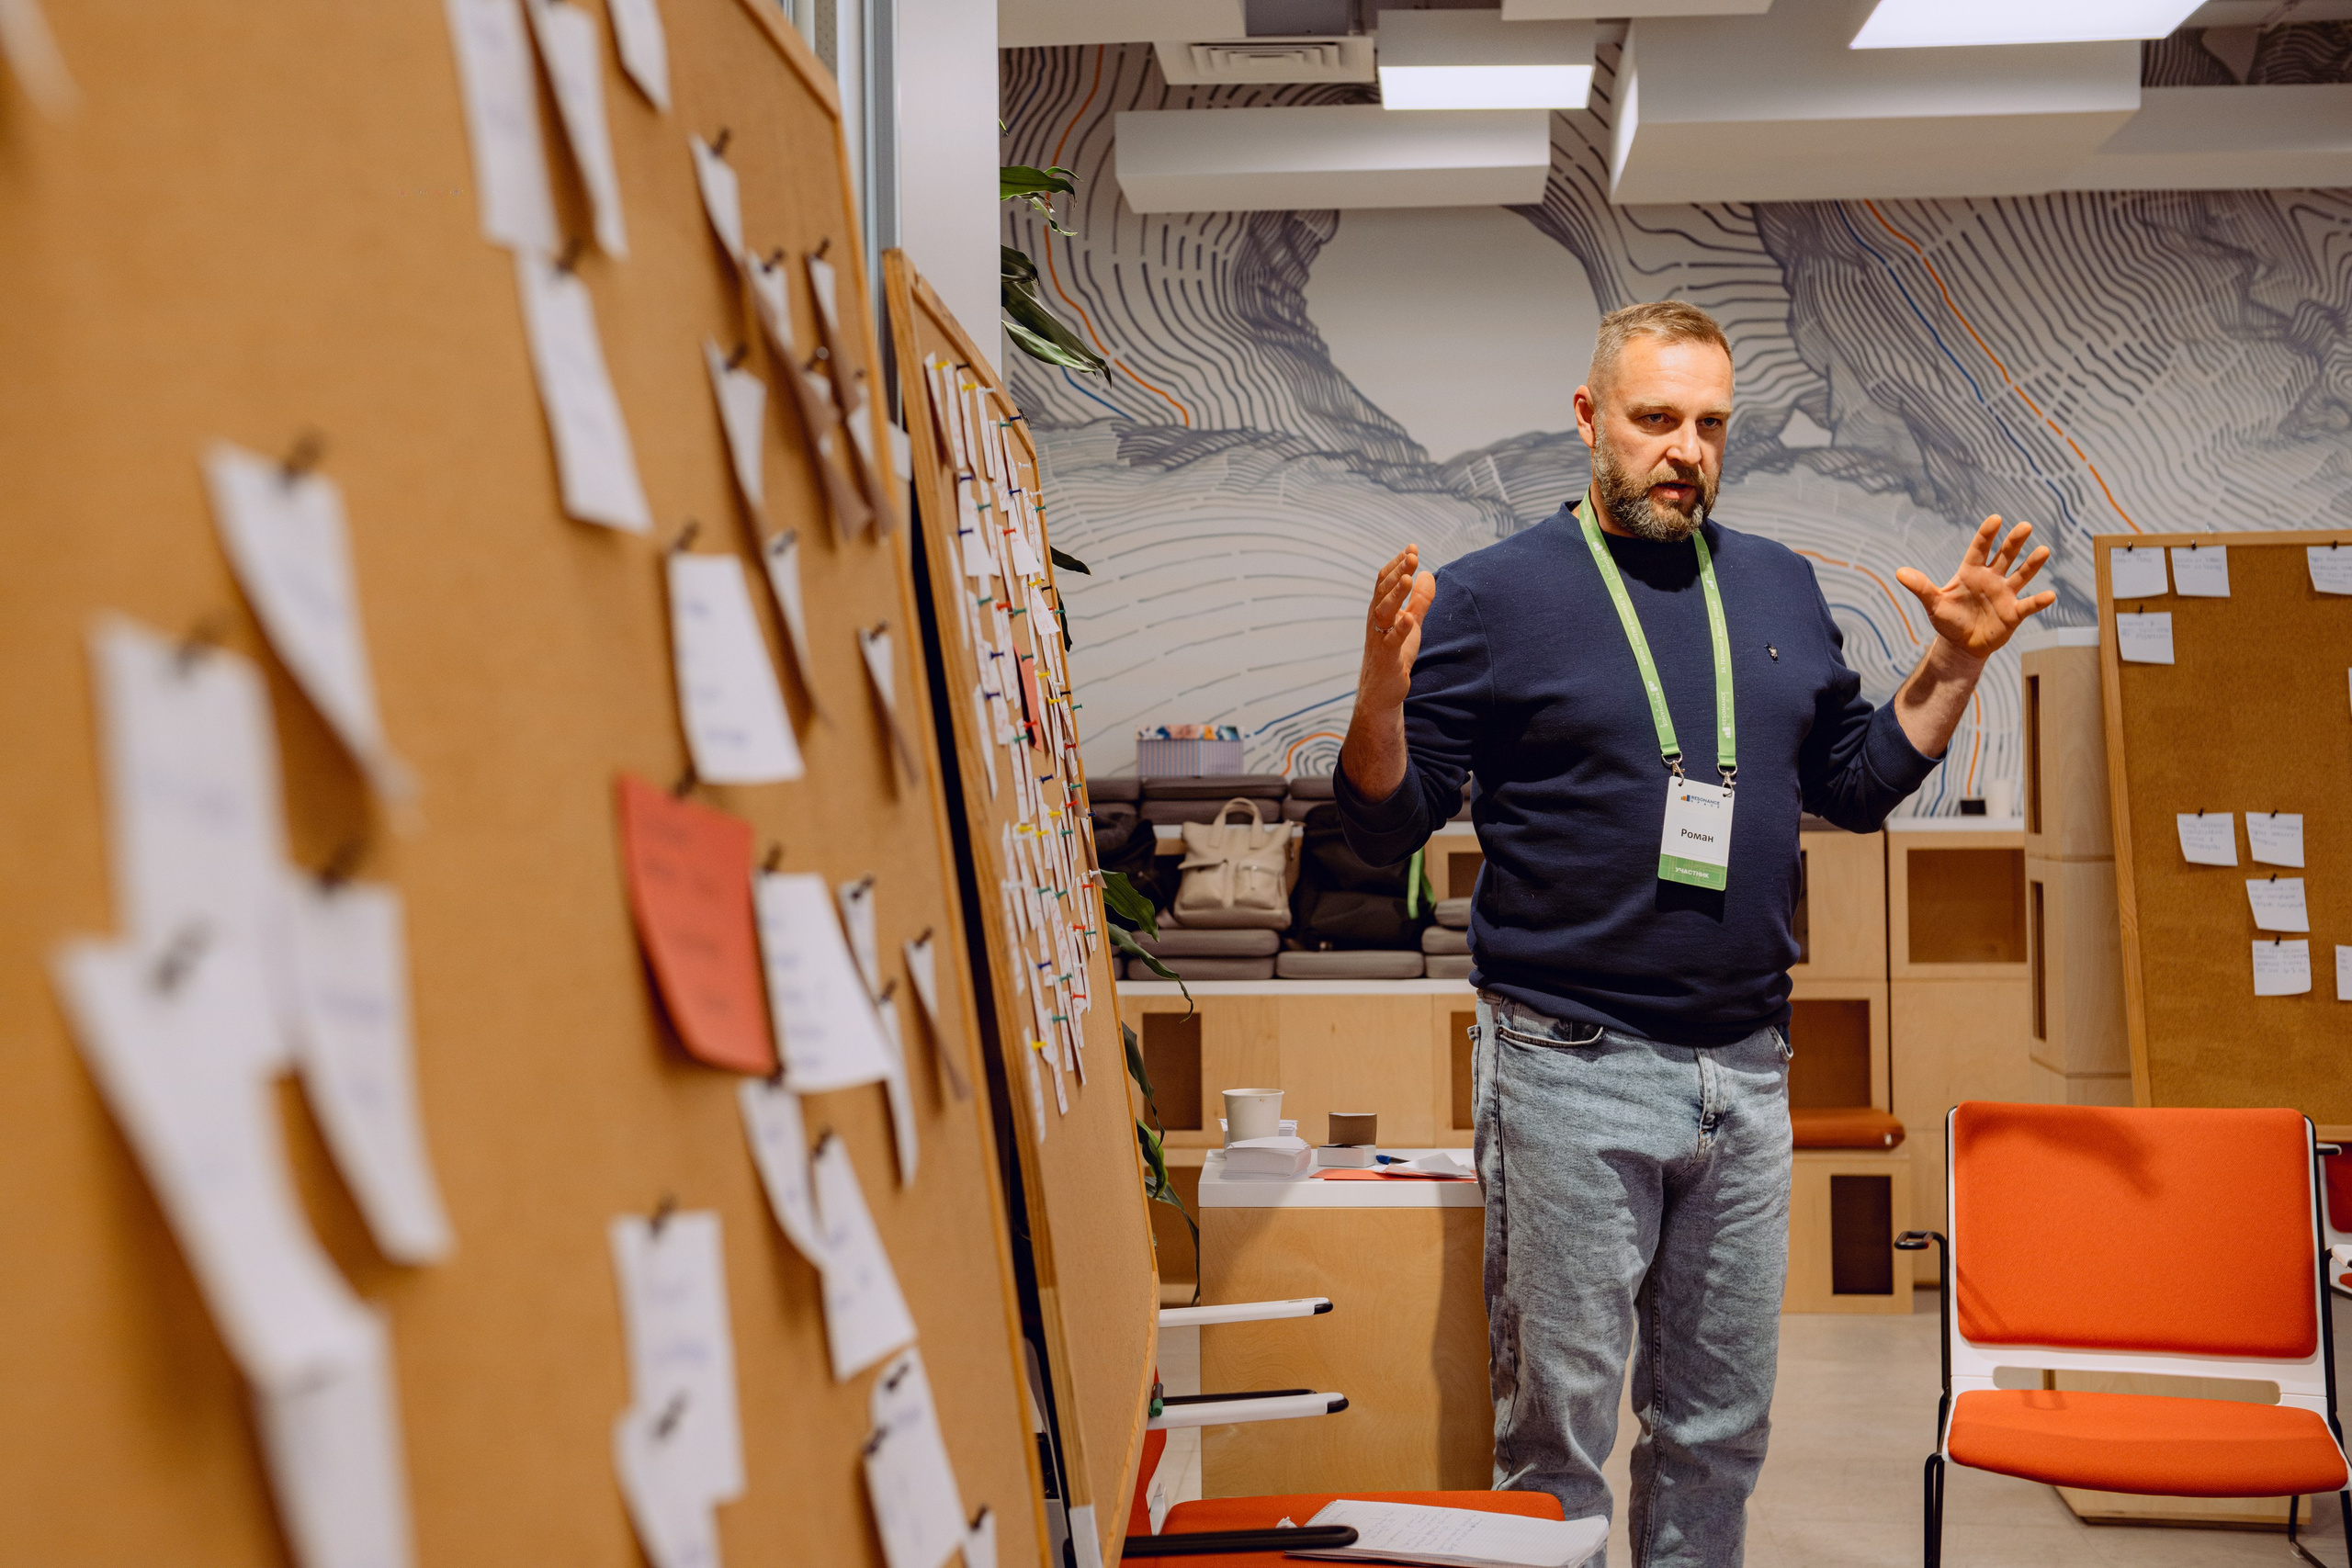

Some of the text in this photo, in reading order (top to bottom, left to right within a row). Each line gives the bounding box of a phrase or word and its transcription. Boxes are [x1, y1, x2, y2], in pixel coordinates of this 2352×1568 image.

[1655, 692, 1668, 727] RESONANCE
[1690, 795, 1720, 806] RESONANCE
[1680, 828, 1714, 843] Роман
[1675, 866, 1710, 879] УЧАСТНИК
